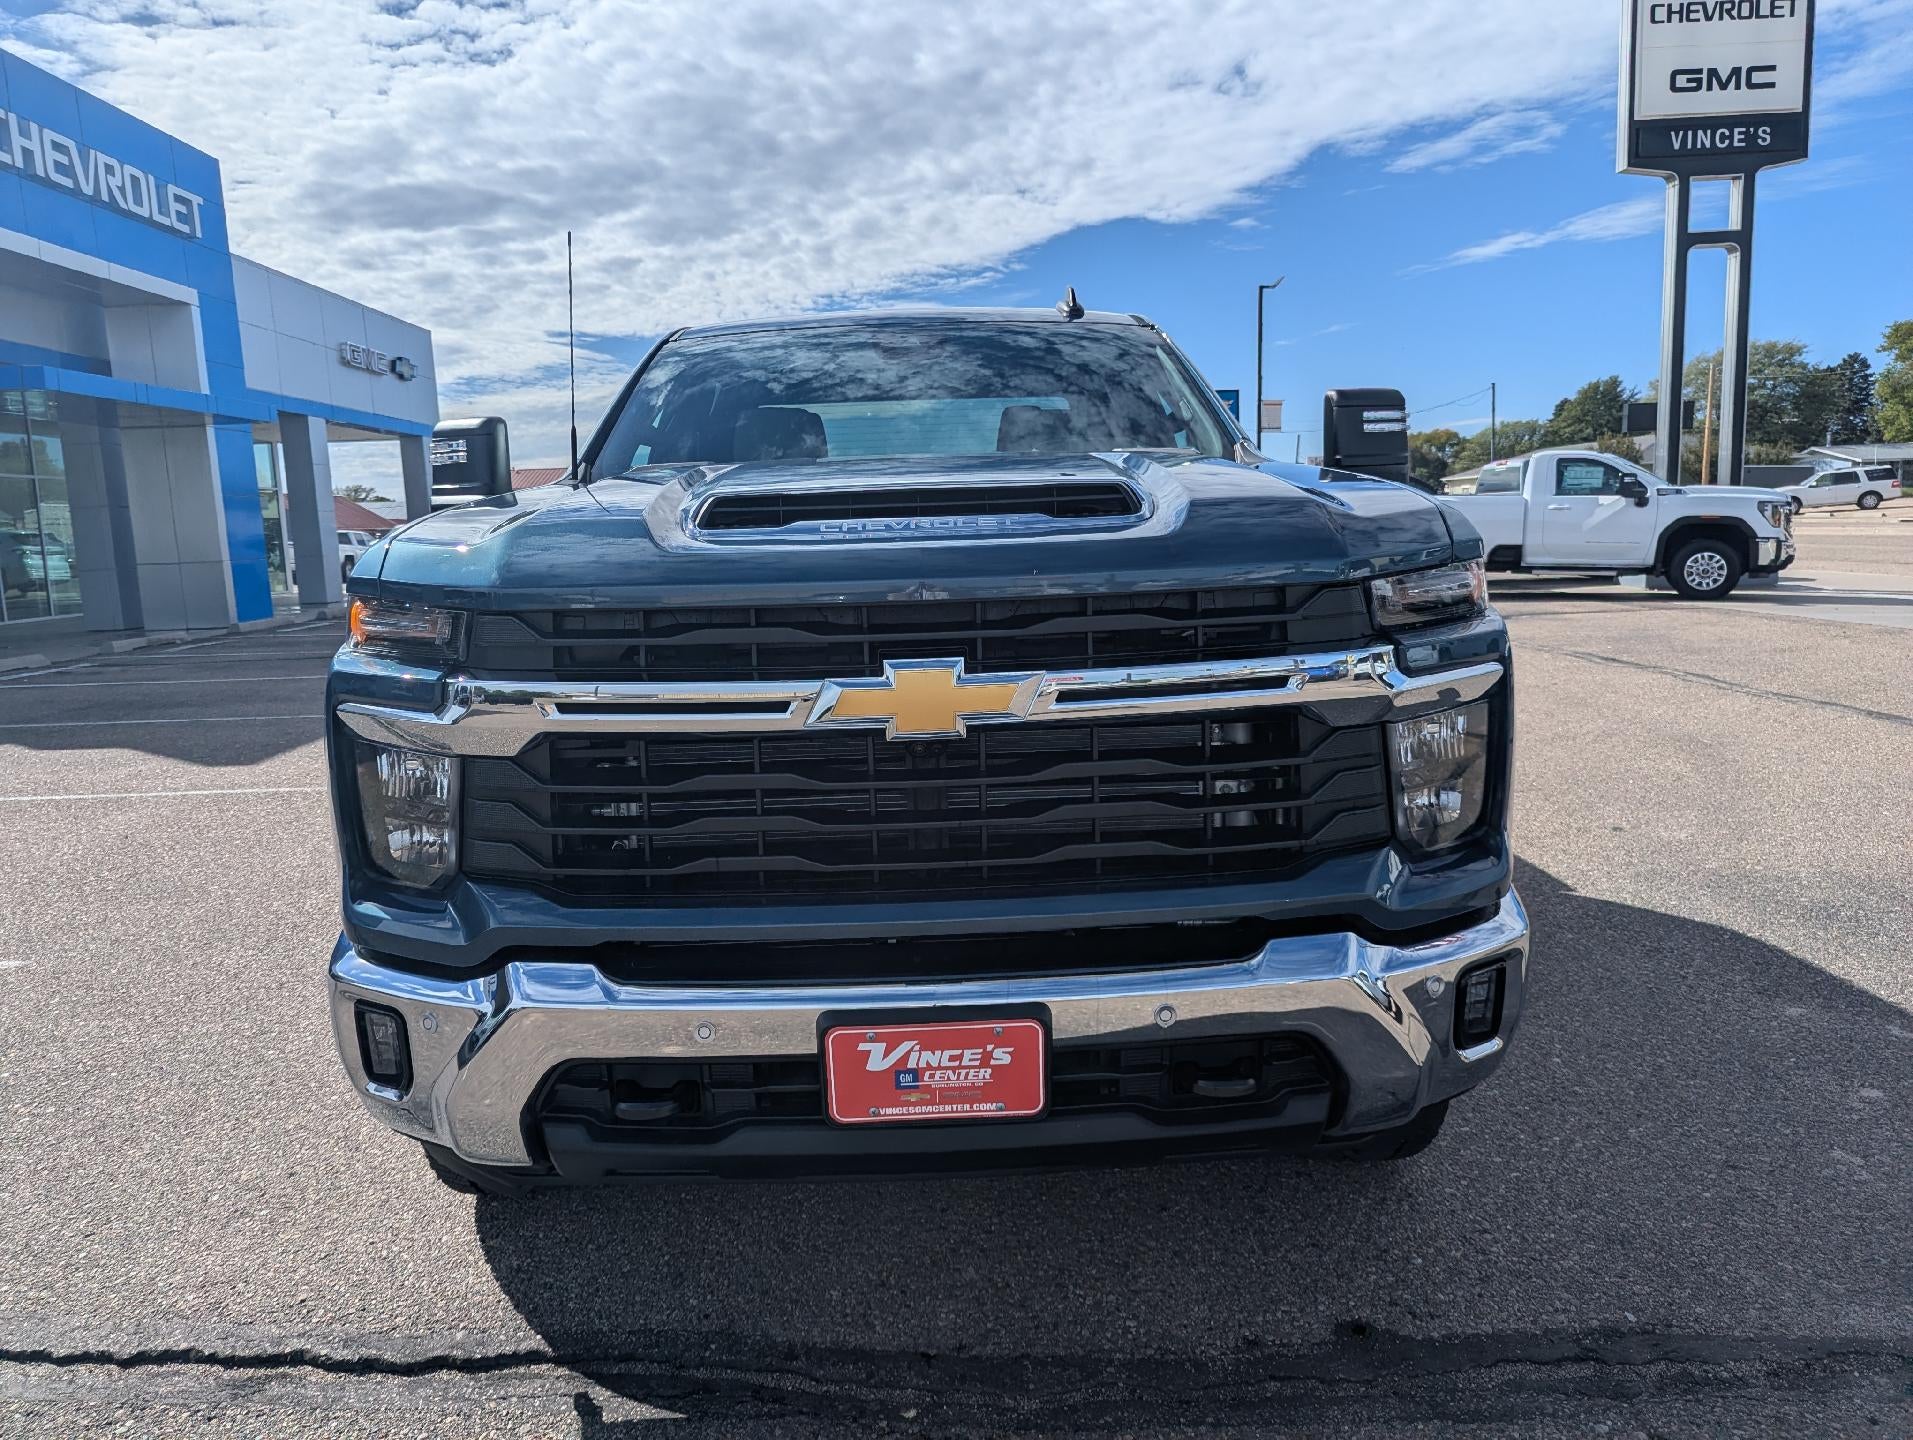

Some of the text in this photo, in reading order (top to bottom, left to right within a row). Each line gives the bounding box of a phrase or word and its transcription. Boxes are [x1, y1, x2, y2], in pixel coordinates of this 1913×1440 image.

[1650, 0, 1799, 24] CHEVROLET
[1669, 65, 1777, 93] GMC
[1671, 126, 1771, 150] VINCE'S
[340, 341, 390, 376] GMC
[820, 516, 1019, 532] CHEVROLET
[900, 1073, 913, 1083] GM
[923, 1068, 992, 1081] CENTER
